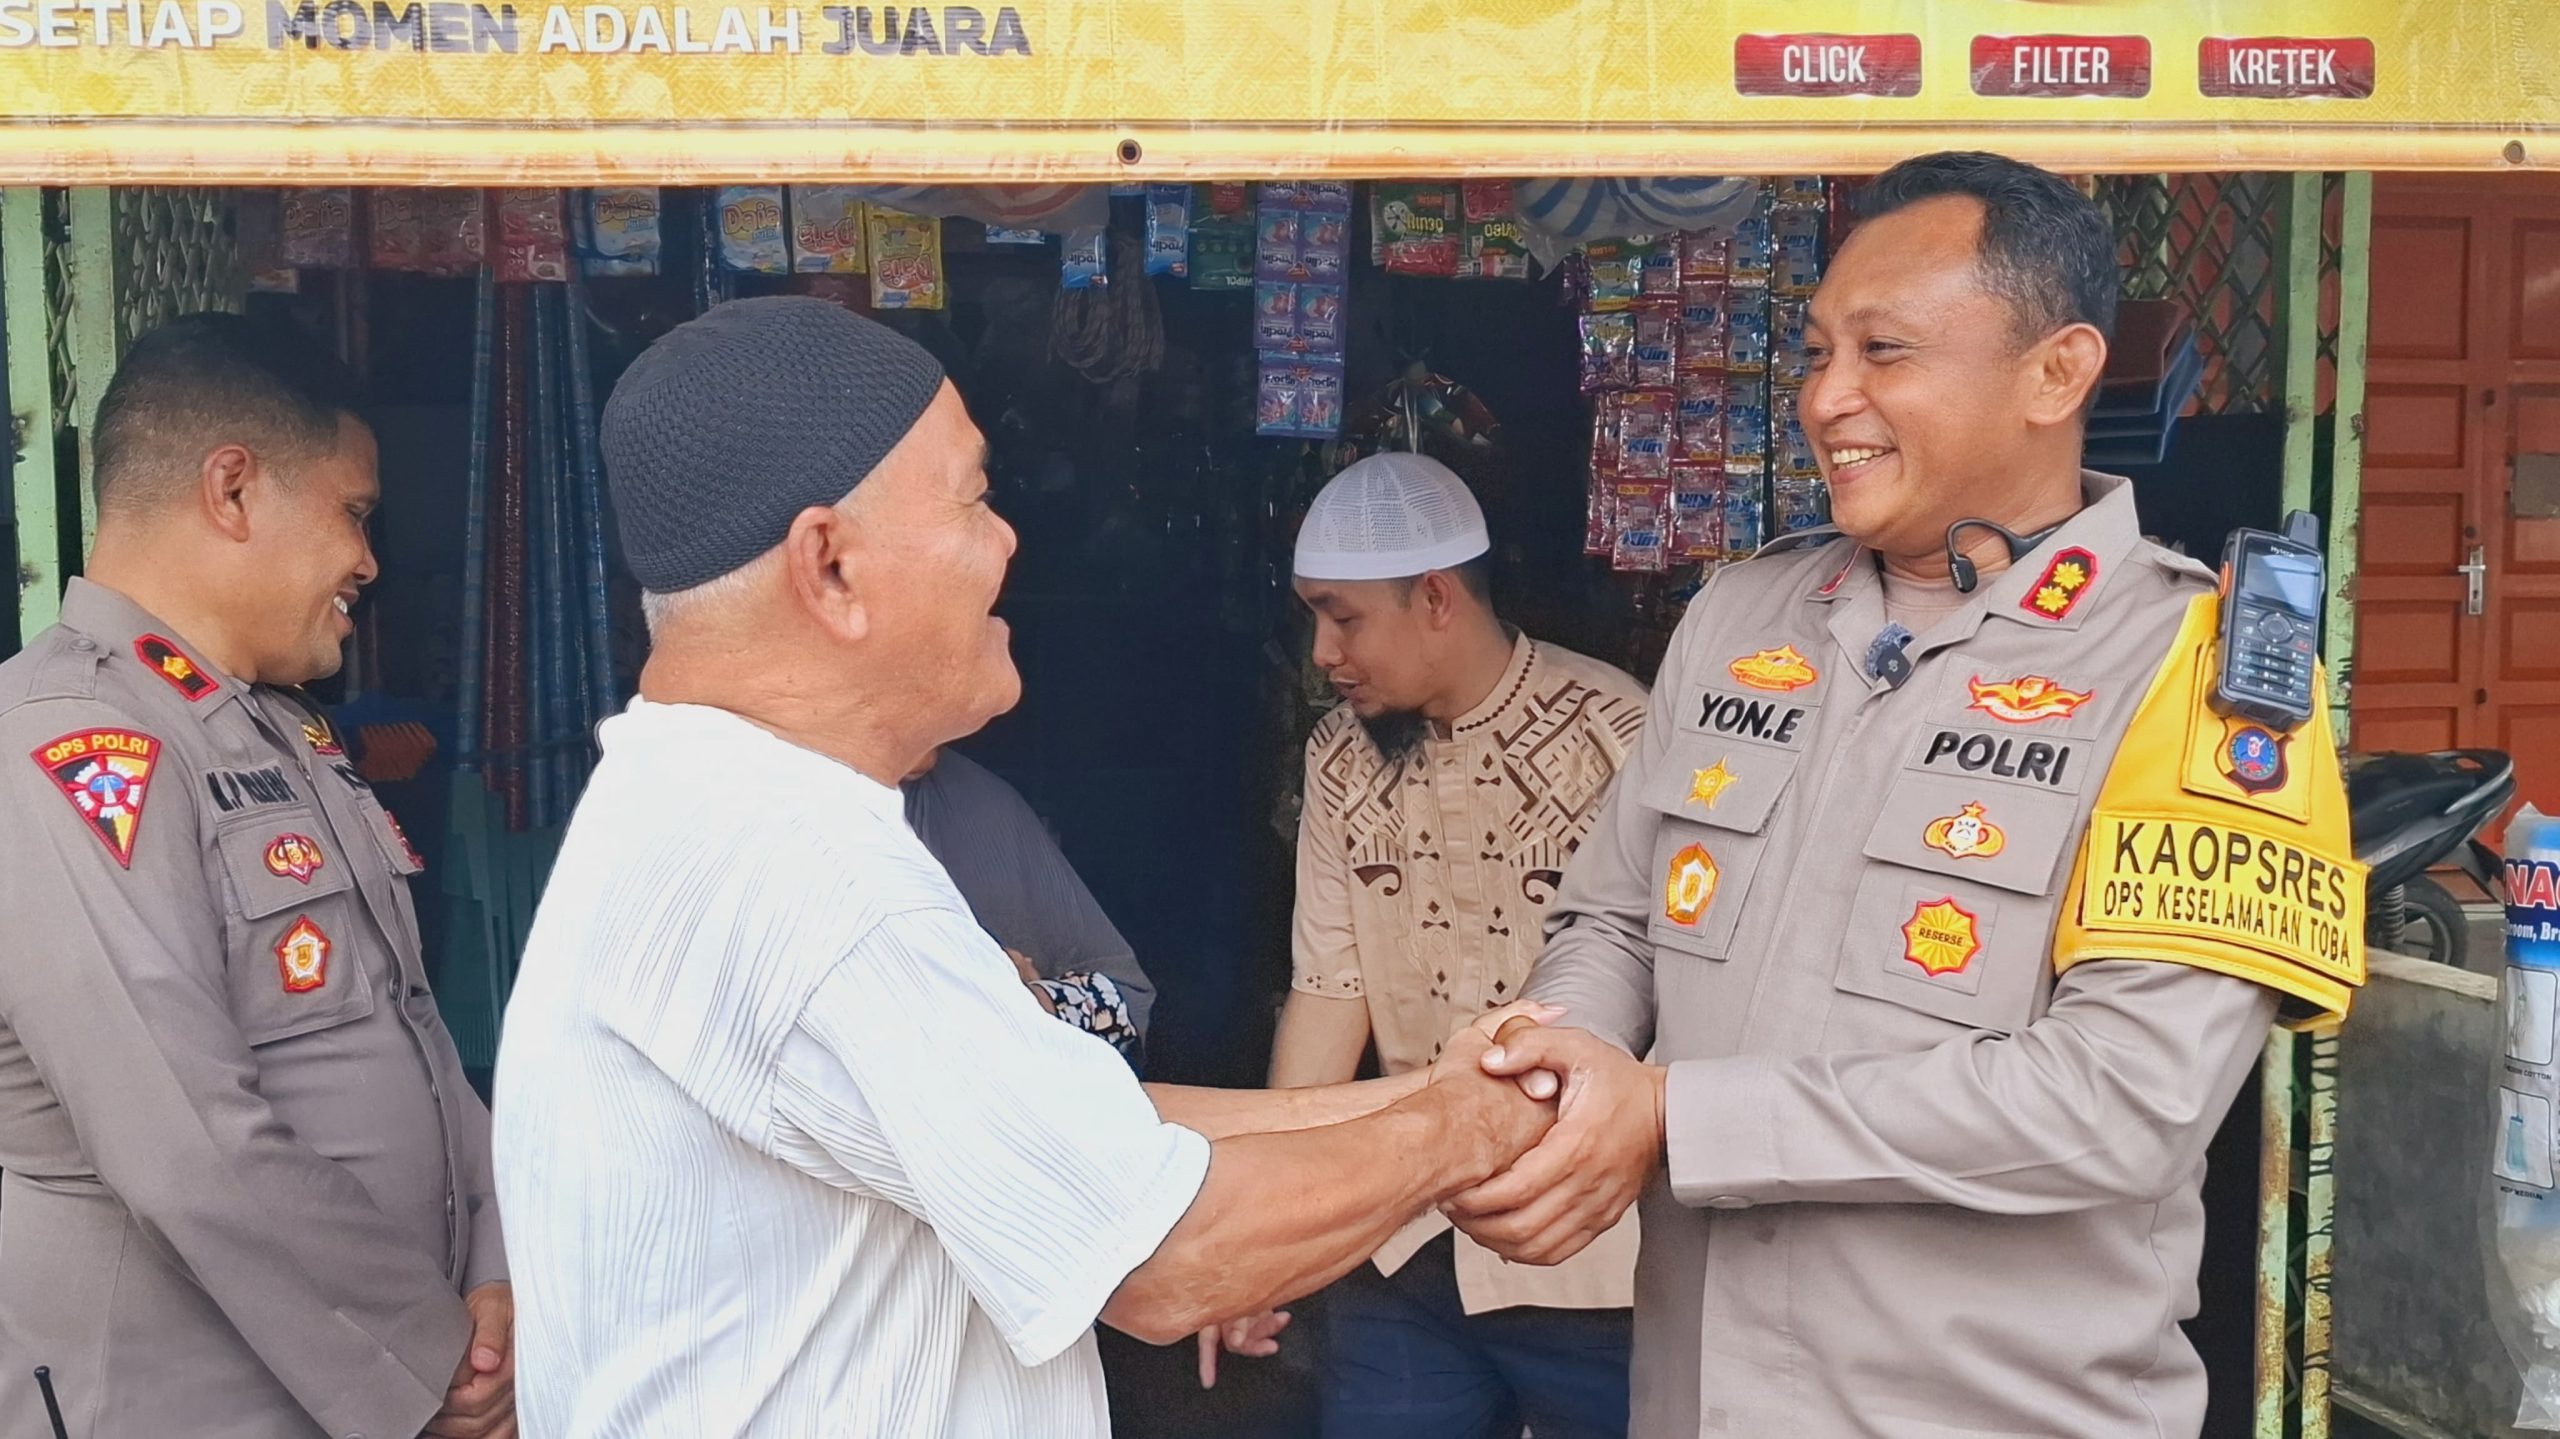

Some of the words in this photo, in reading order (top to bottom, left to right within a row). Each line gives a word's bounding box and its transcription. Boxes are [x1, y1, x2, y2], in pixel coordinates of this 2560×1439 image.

[0, 0, 246, 49] SETIAP
[266, 0, 519, 53] MOMEN
[537, 4, 801, 54] ADALAH
[822, 5, 1033, 56] JUARA
[1783, 44, 1866, 83] CLICK
[2013, 45, 2109, 84] FILTER
[2228, 47, 2337, 86] KRETEK
[1698, 692, 1805, 744] YON.E
[45, 737, 87, 763] OPS
[91, 733, 151, 755] POLRI
[1923, 730, 2071, 786] POLRI
[2113, 821, 2346, 921] KAOPSRES
[2505, 863, 2560, 910] NA
[1918, 926, 1964, 948] RESERSE
[2104, 880, 2144, 918] OPS
[2156, 883, 2302, 947] KESELAMATAN
[2309, 916, 2351, 968] TOBA
